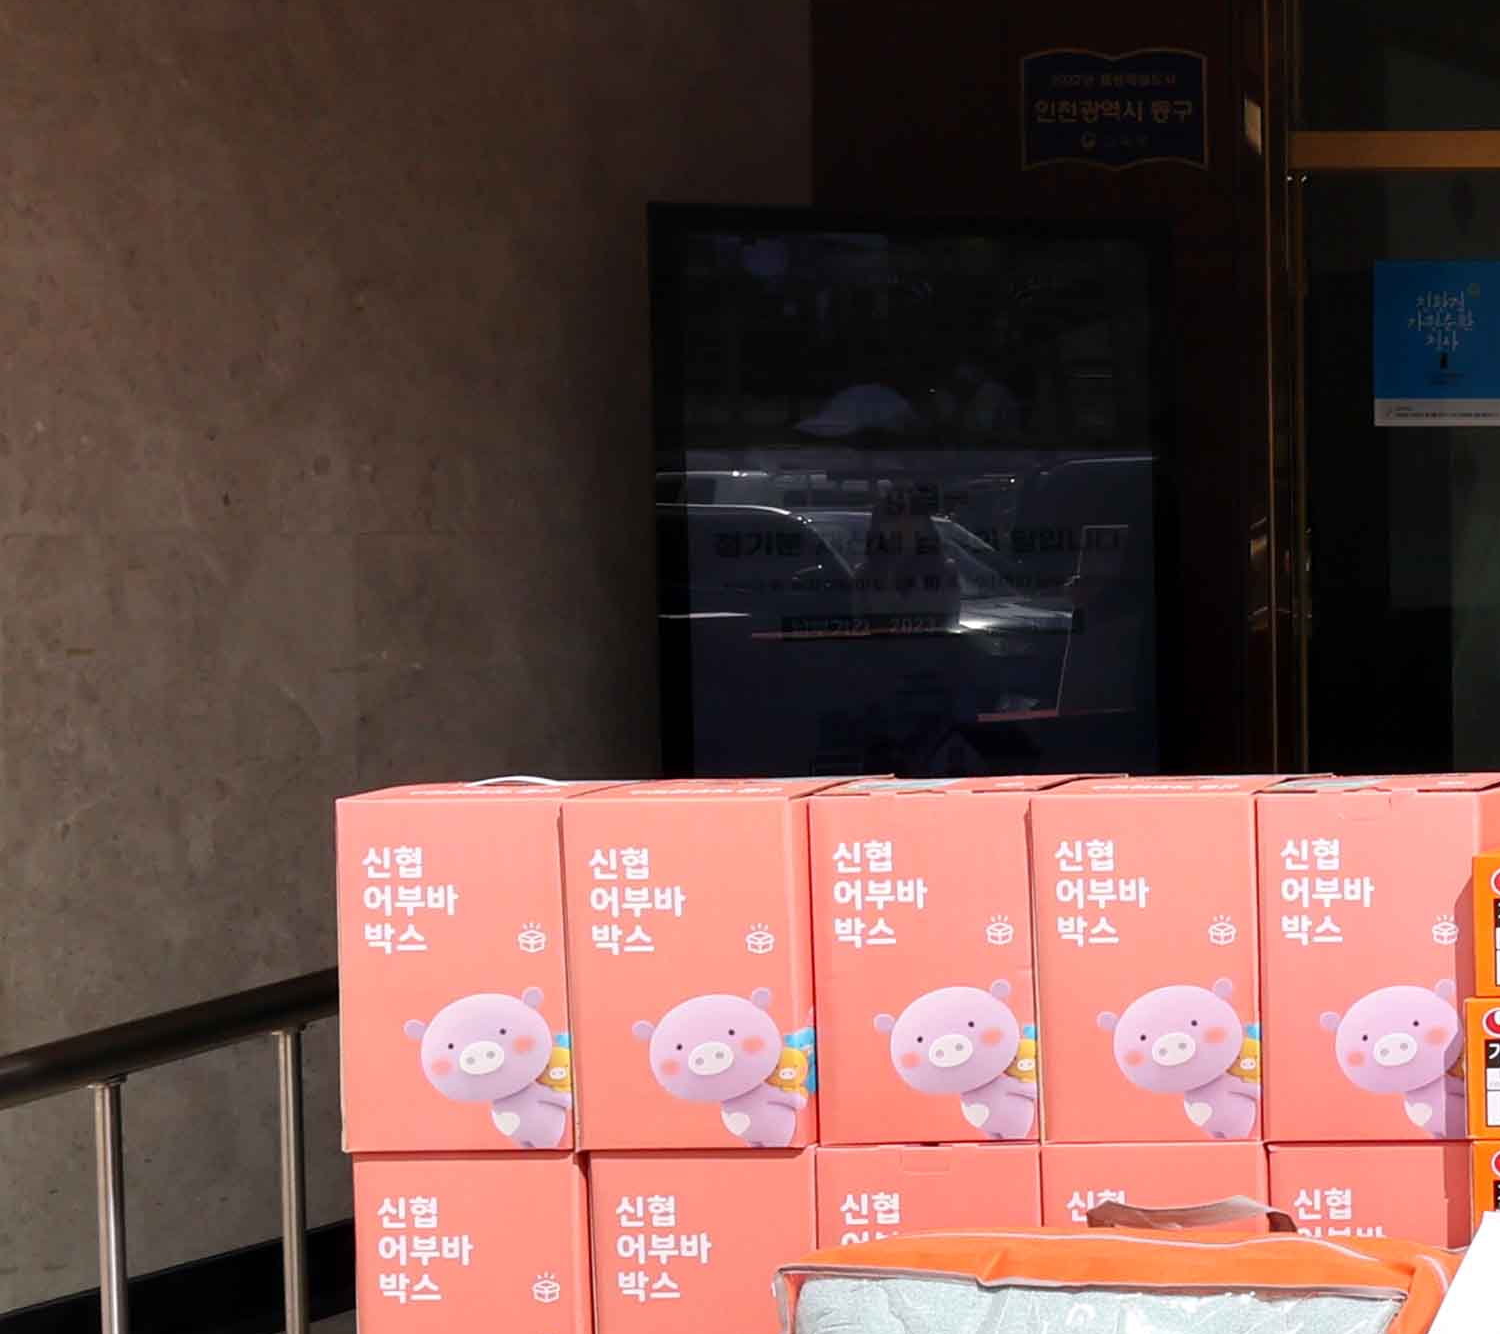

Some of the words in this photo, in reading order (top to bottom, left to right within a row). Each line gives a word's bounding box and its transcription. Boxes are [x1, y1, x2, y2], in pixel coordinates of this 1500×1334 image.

[363, 846, 422, 878] 신협
[589, 847, 649, 879] 신협
[833, 840, 892, 872] 신협
[1056, 839, 1114, 871] 신협
[364, 885, 458, 916] 어부바
[591, 886, 686, 917] 어부바
[834, 878, 927, 910] 어부바
[1056, 878, 1149, 909] 어부바
[365, 923, 427, 954] 박스
[592, 924, 654, 955] 박스
[834, 917, 896, 948] 박스
[1058, 916, 1119, 947] 박스
[378, 1196, 437, 1228] 신협
[379, 1235, 473, 1265] 어부바
[380, 1273, 441, 1303] 박스
